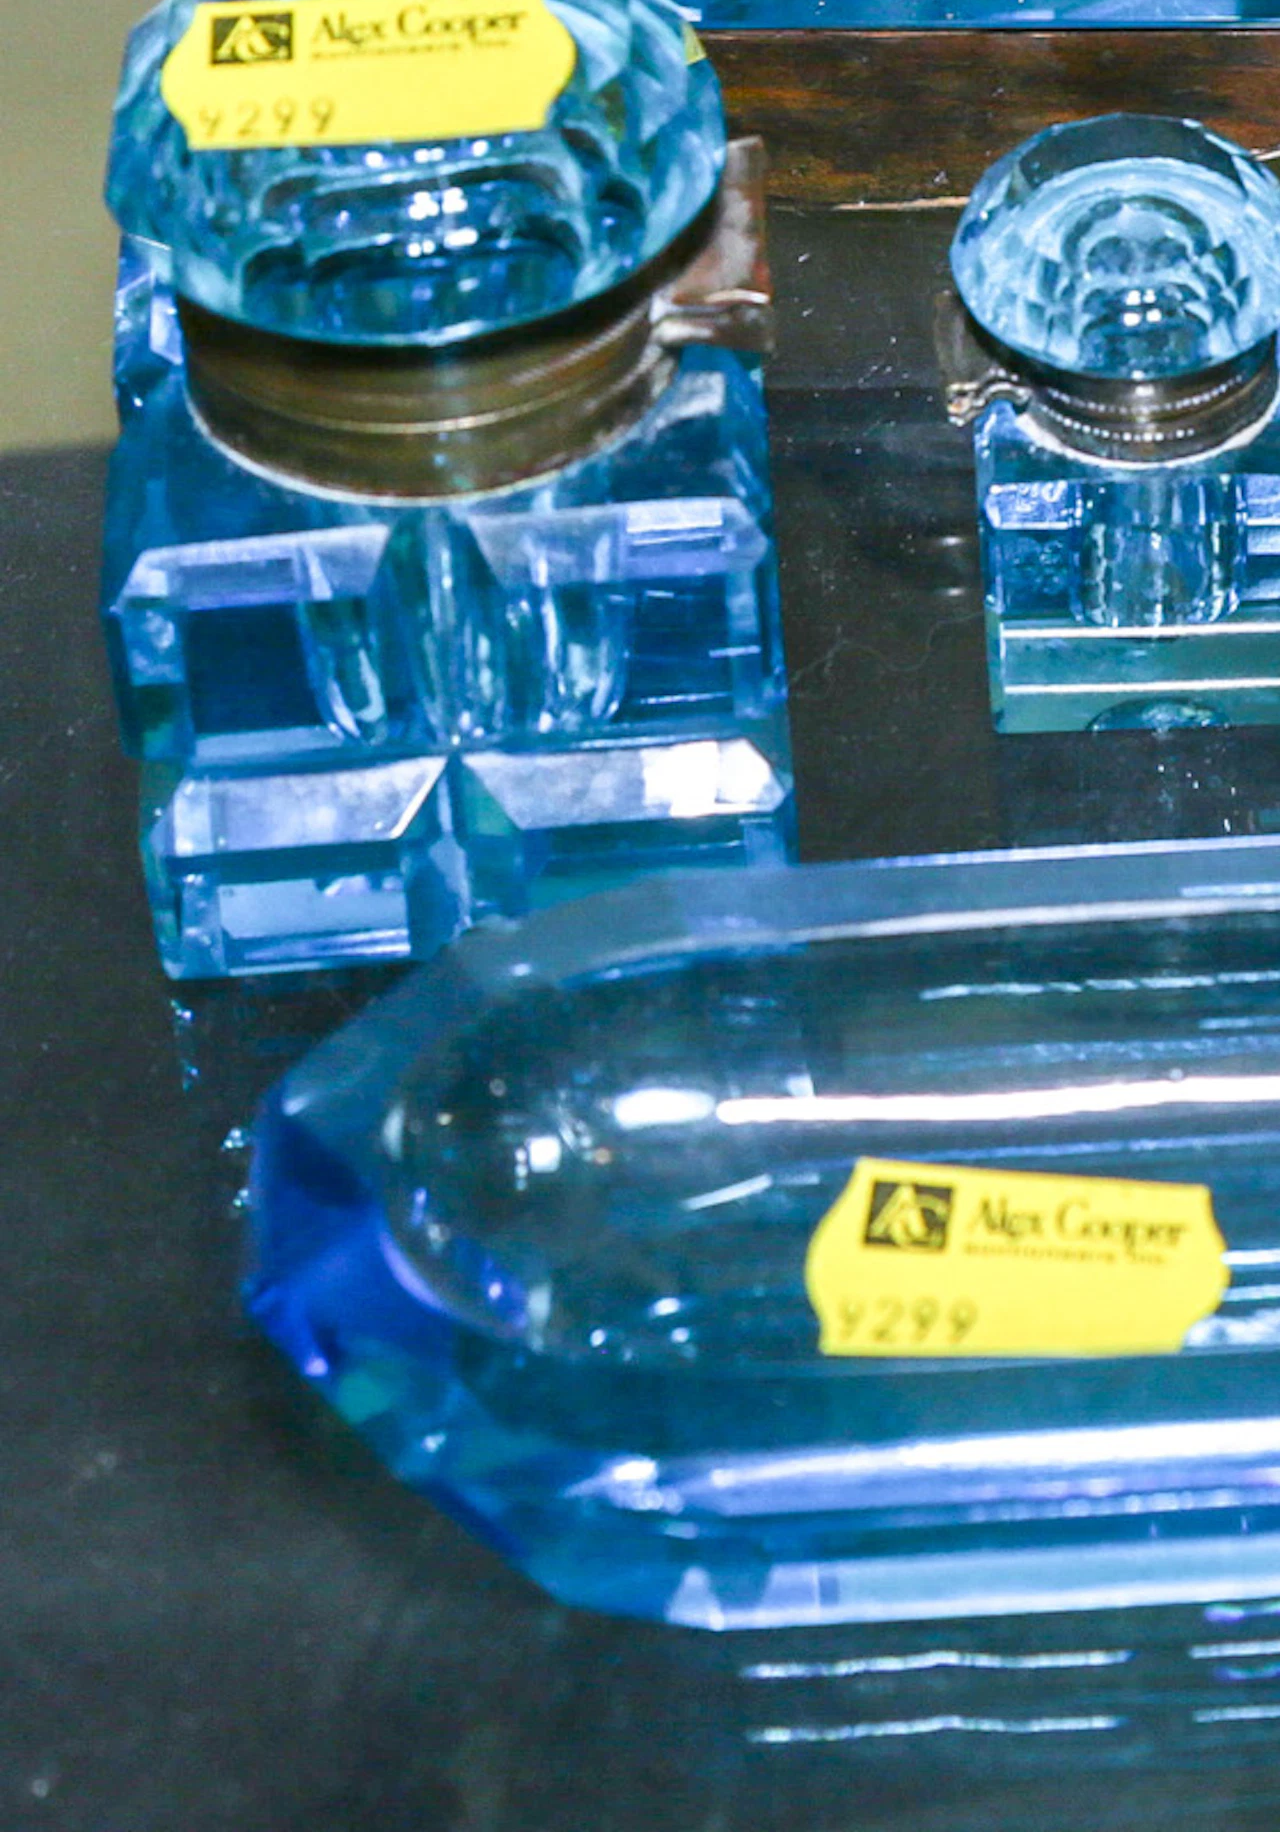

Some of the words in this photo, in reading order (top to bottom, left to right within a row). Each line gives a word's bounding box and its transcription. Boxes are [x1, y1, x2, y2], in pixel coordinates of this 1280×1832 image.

[312, 12, 387, 45] Alex
[397, 4, 527, 46] Cooper
[967, 1195, 1043, 1236] Alex
[1054, 1196, 1189, 1249] Cooper
